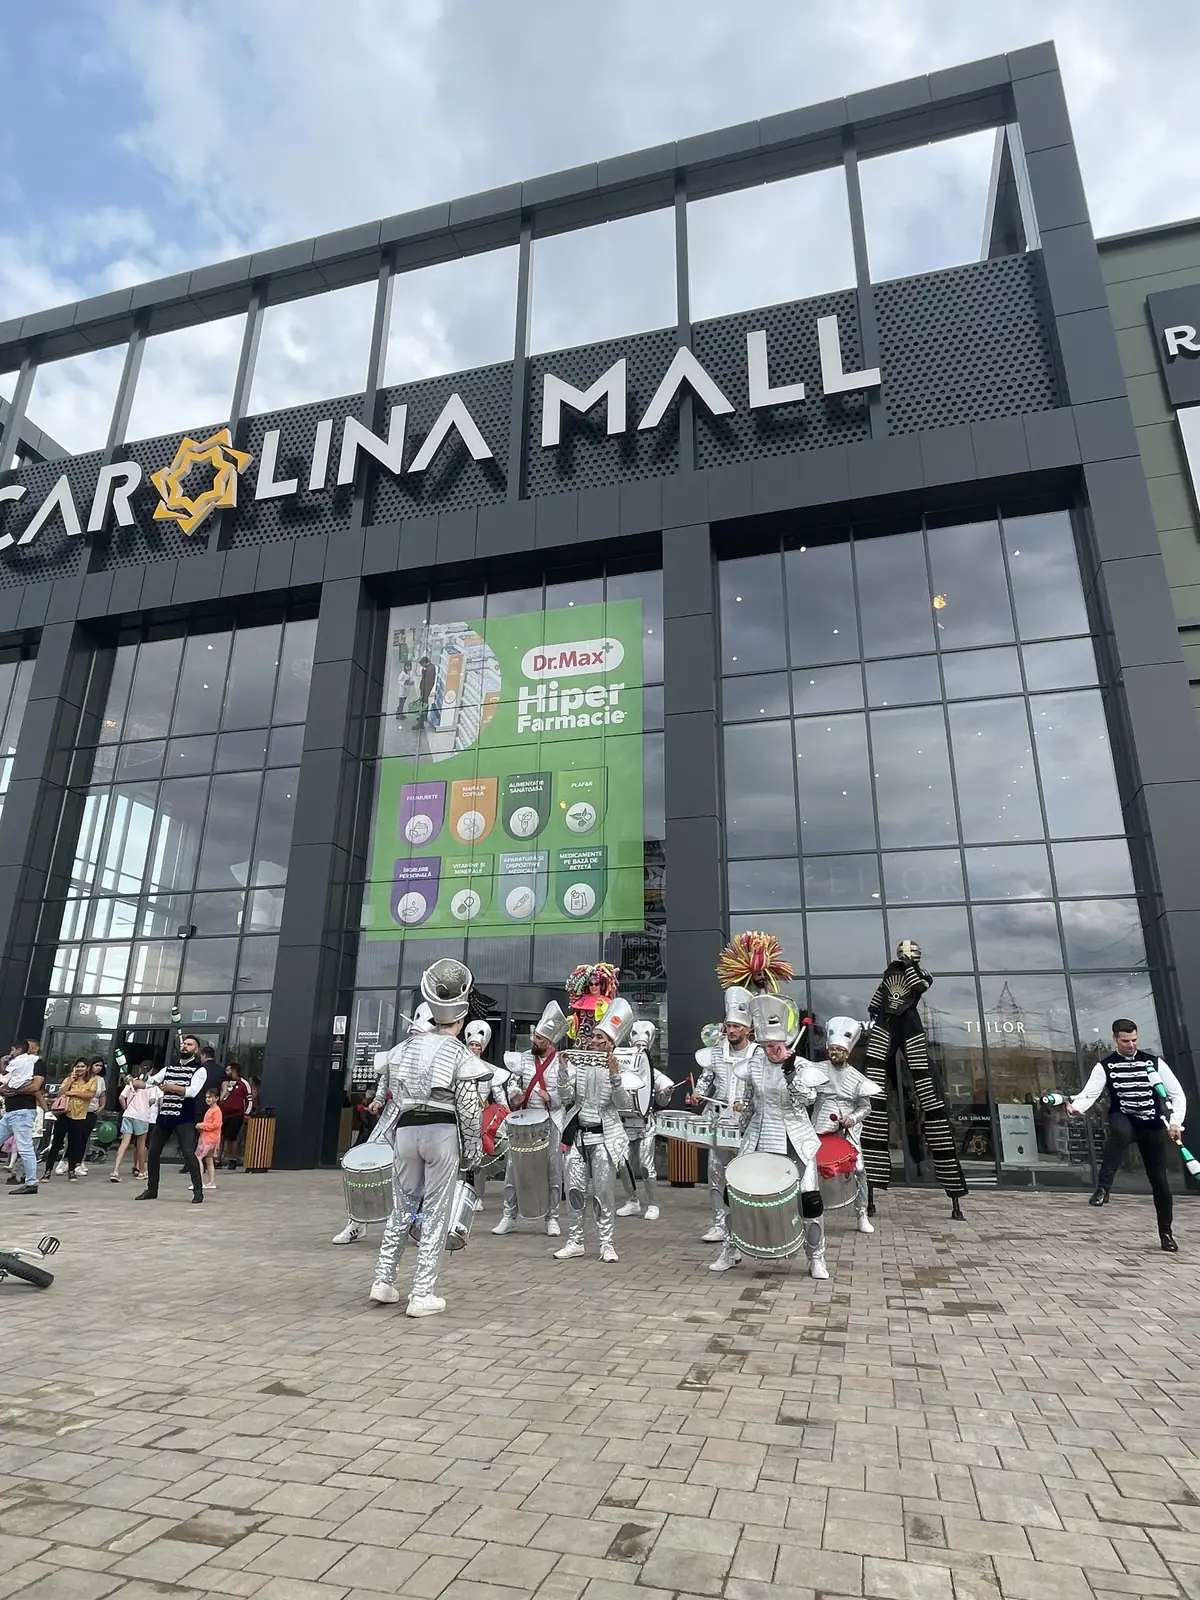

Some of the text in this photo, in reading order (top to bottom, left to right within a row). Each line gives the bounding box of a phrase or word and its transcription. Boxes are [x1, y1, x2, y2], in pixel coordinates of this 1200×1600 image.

[541, 315, 881, 447] MALL
[518, 681, 625, 716] Hiper
[517, 705, 625, 733] Farmacie
